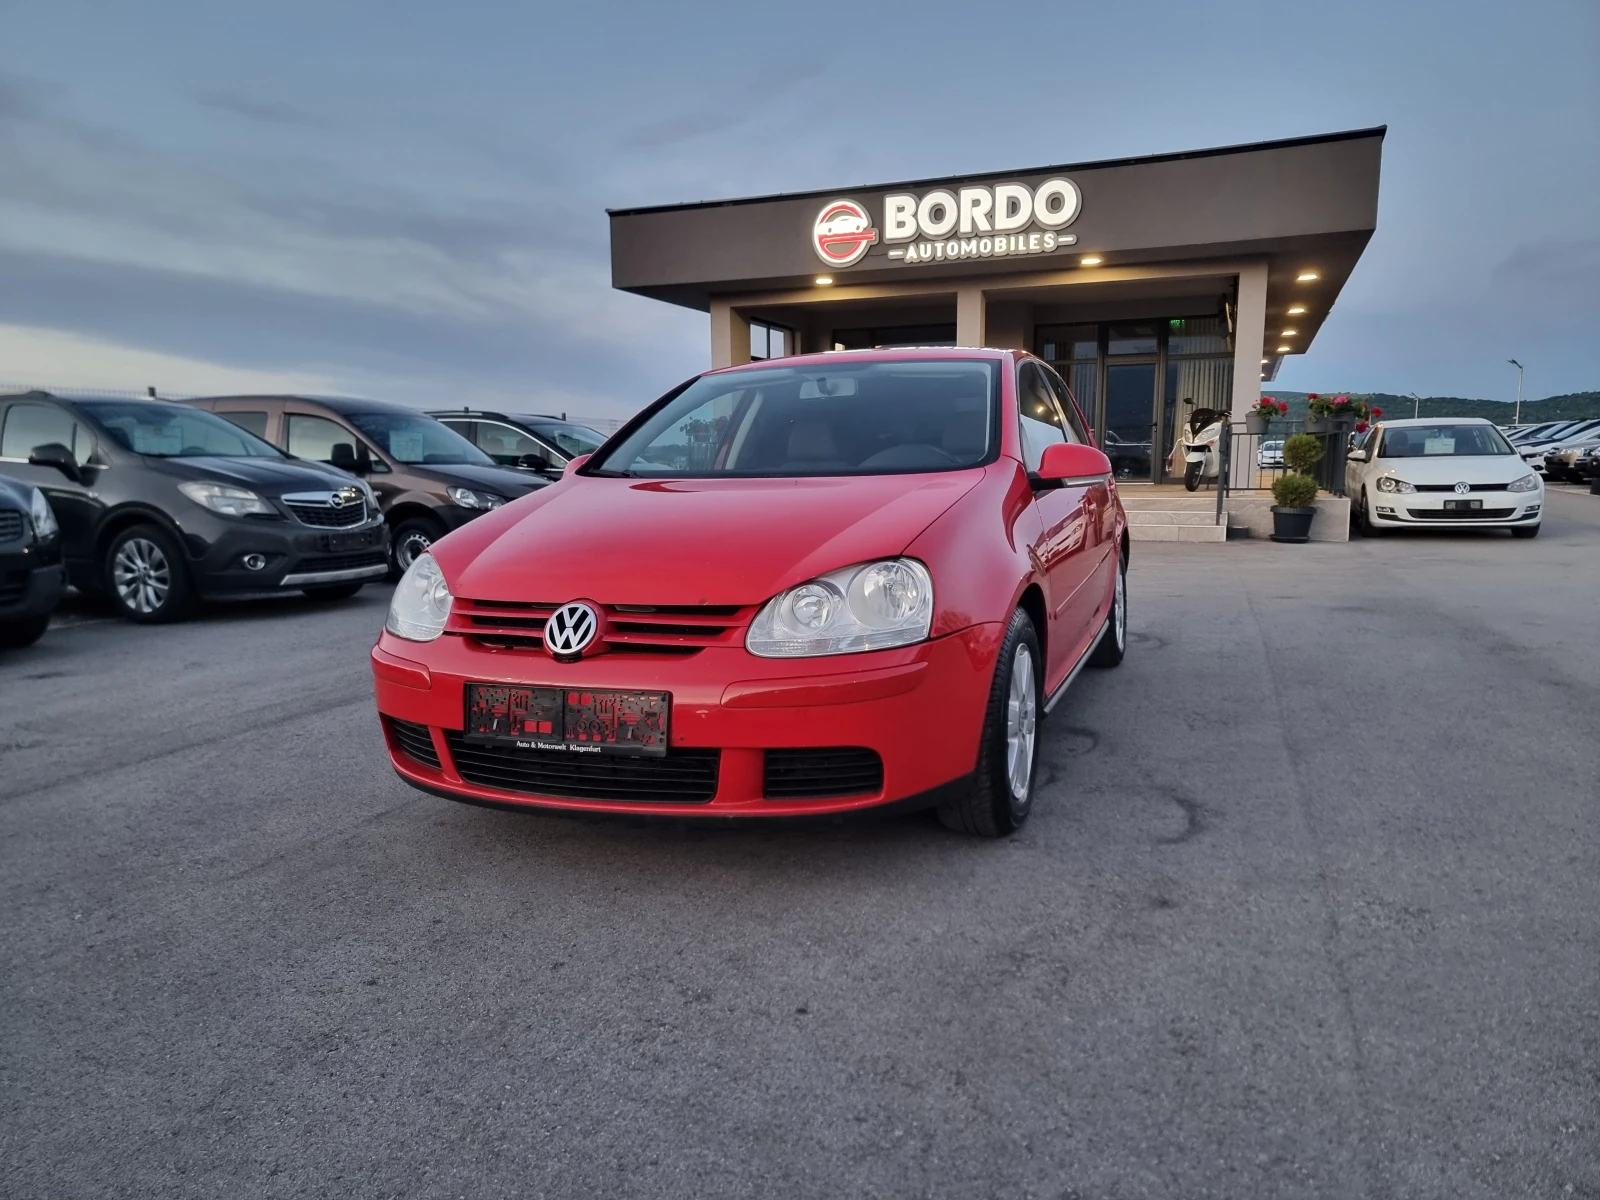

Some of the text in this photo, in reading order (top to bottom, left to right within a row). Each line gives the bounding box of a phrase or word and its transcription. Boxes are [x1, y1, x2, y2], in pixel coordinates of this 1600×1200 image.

[885, 180, 1077, 239] BORDO
[905, 233, 1055, 261] AUTOMOBILES
[545, 603, 597, 654] VW
[537, 742, 567, 750] Motorwelt
[569, 744, 601, 752] Klagenfurt
